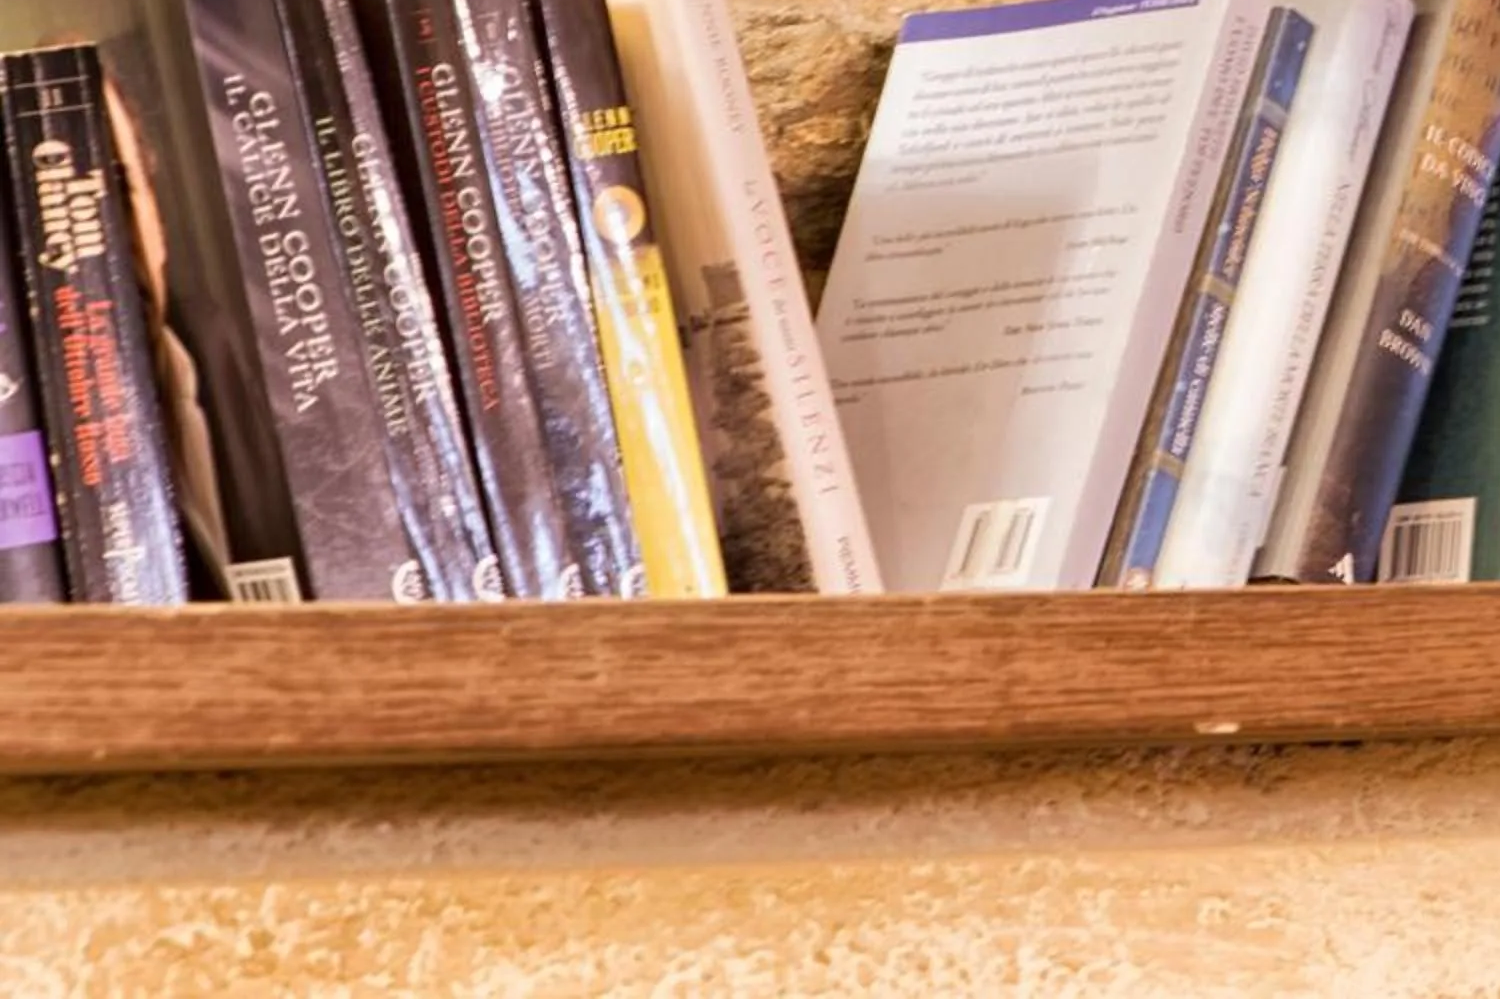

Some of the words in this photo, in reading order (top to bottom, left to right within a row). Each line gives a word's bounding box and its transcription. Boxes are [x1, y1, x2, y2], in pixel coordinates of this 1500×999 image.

[220, 73, 246, 105] IL
[312, 115, 337, 144] IL
[230, 111, 274, 225] CALICE
[1421, 153, 1448, 179] DA
[1426, 125, 1448, 148] IL
[33, 138, 78, 276] Clancy
[66, 168, 109, 259] Tom
[248, 89, 301, 221] GLENN
[280, 227, 340, 384] COOPER
[321, 150, 361, 238] LIBRO
[432, 60, 475, 179] GLENN
[456, 183, 503, 325] COOPER
[258, 230, 301, 335] DELLA
[345, 243, 386, 336] DELLE
[350, 130, 395, 253] GLENN
[382, 258, 438, 405] COOPER
[420, 78, 452, 184] CUSTODI
[441, 190, 468, 266] DELLA
[456, 271, 499, 411] BIBLIOTECA
[284, 340, 320, 414] VITA
[521, 293, 554, 370] MORTI
[746, 198, 785, 291] VOCE
[783, 352, 840, 496] SILENZI
[1378, 328, 1432, 375] BROWN
[367, 340, 410, 438] ANIME
